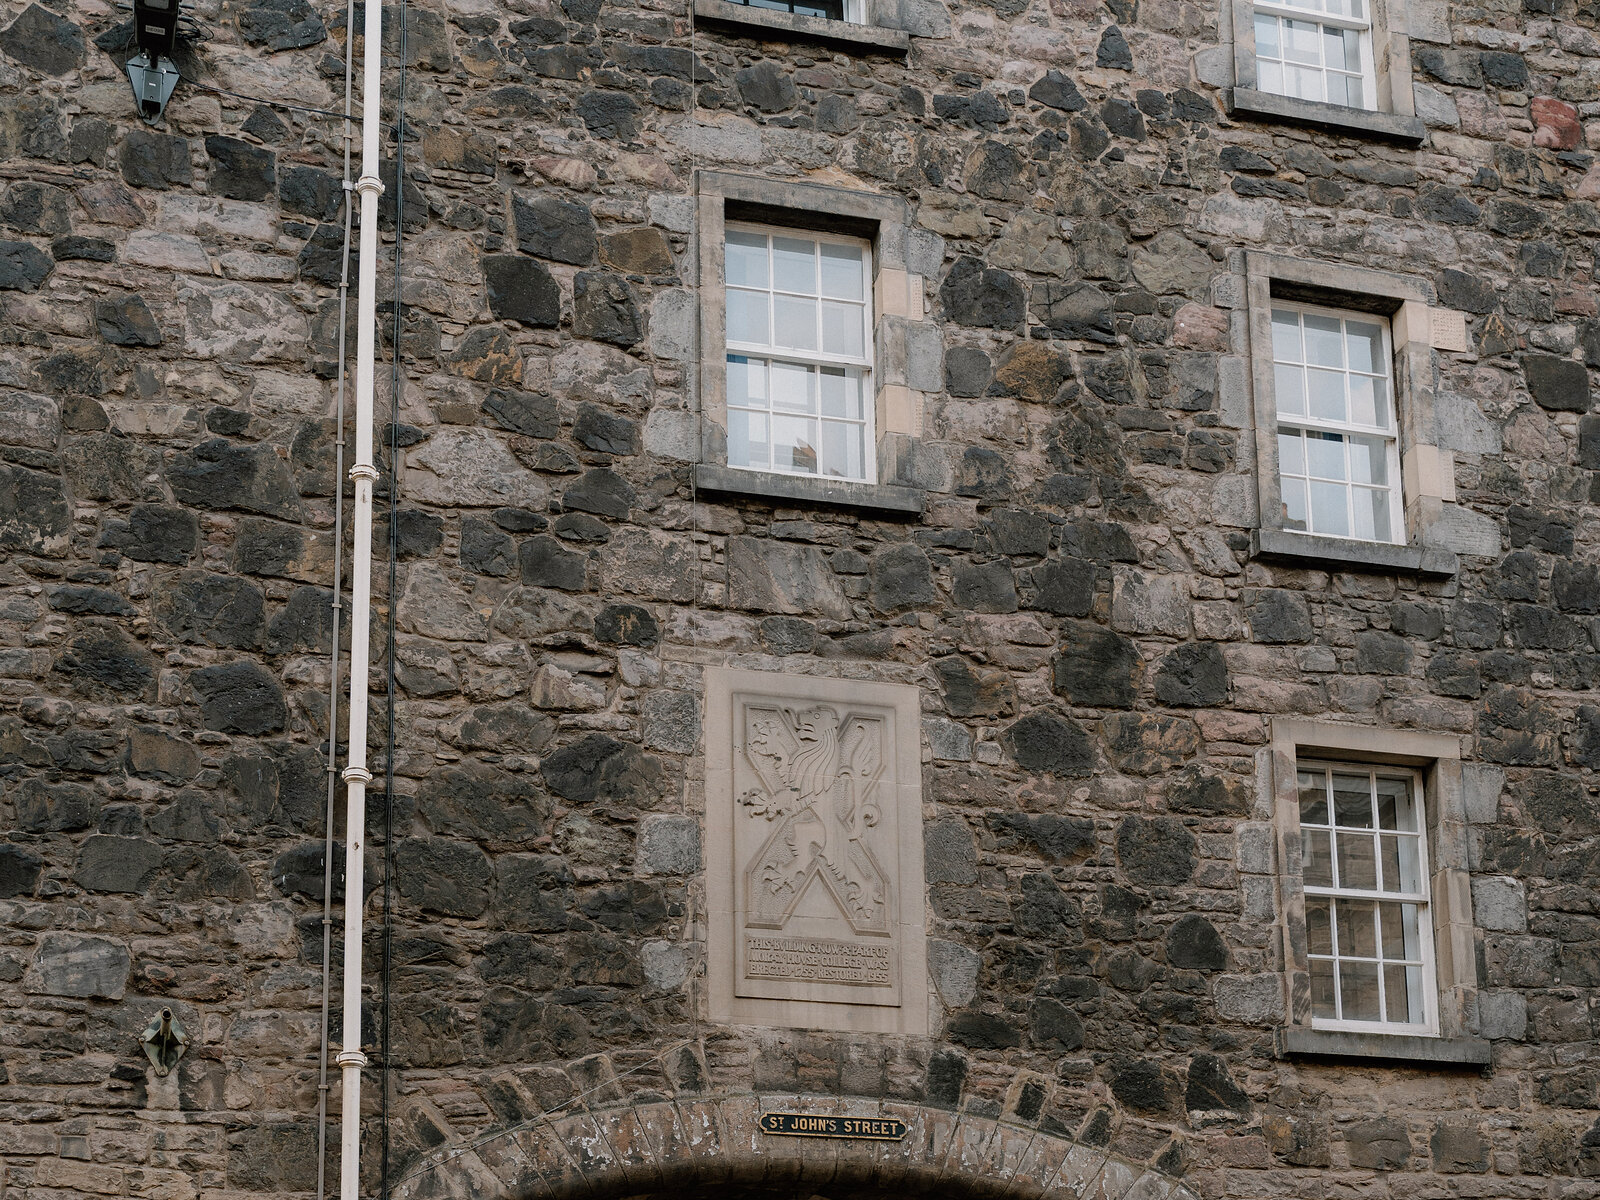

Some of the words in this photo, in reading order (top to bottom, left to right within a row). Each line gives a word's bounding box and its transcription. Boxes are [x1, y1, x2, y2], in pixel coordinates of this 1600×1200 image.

[748, 939, 771, 950] THIS
[818, 943, 838, 956] NOW
[821, 956, 861, 969] COLLEGE
[865, 959, 889, 971] WAS
[749, 964, 791, 976] ERECTED
[818, 969, 864, 981] RESTORED
[867, 971, 888, 983] 1955
[791, 1118, 837, 1132] JOHN'S
[844, 1120, 899, 1135] STREET
